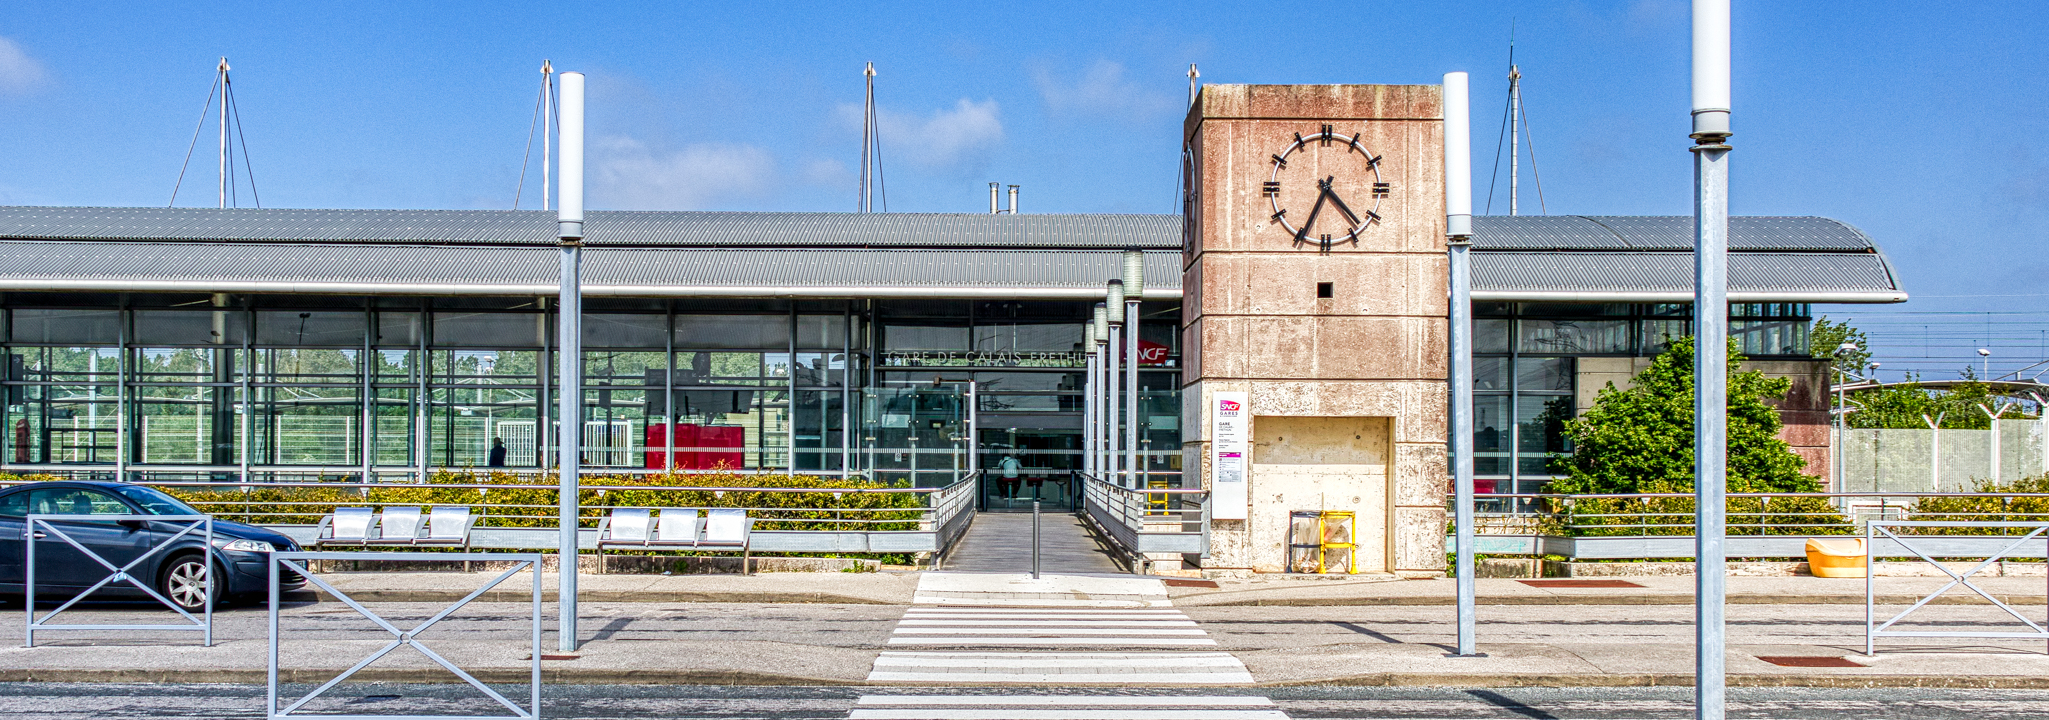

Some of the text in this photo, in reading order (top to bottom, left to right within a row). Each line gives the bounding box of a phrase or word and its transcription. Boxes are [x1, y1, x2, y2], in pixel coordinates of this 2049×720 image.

[888, 351, 1097, 364] GARE DE CALAIS FRETHU
[1123, 347, 1167, 361] NCF
